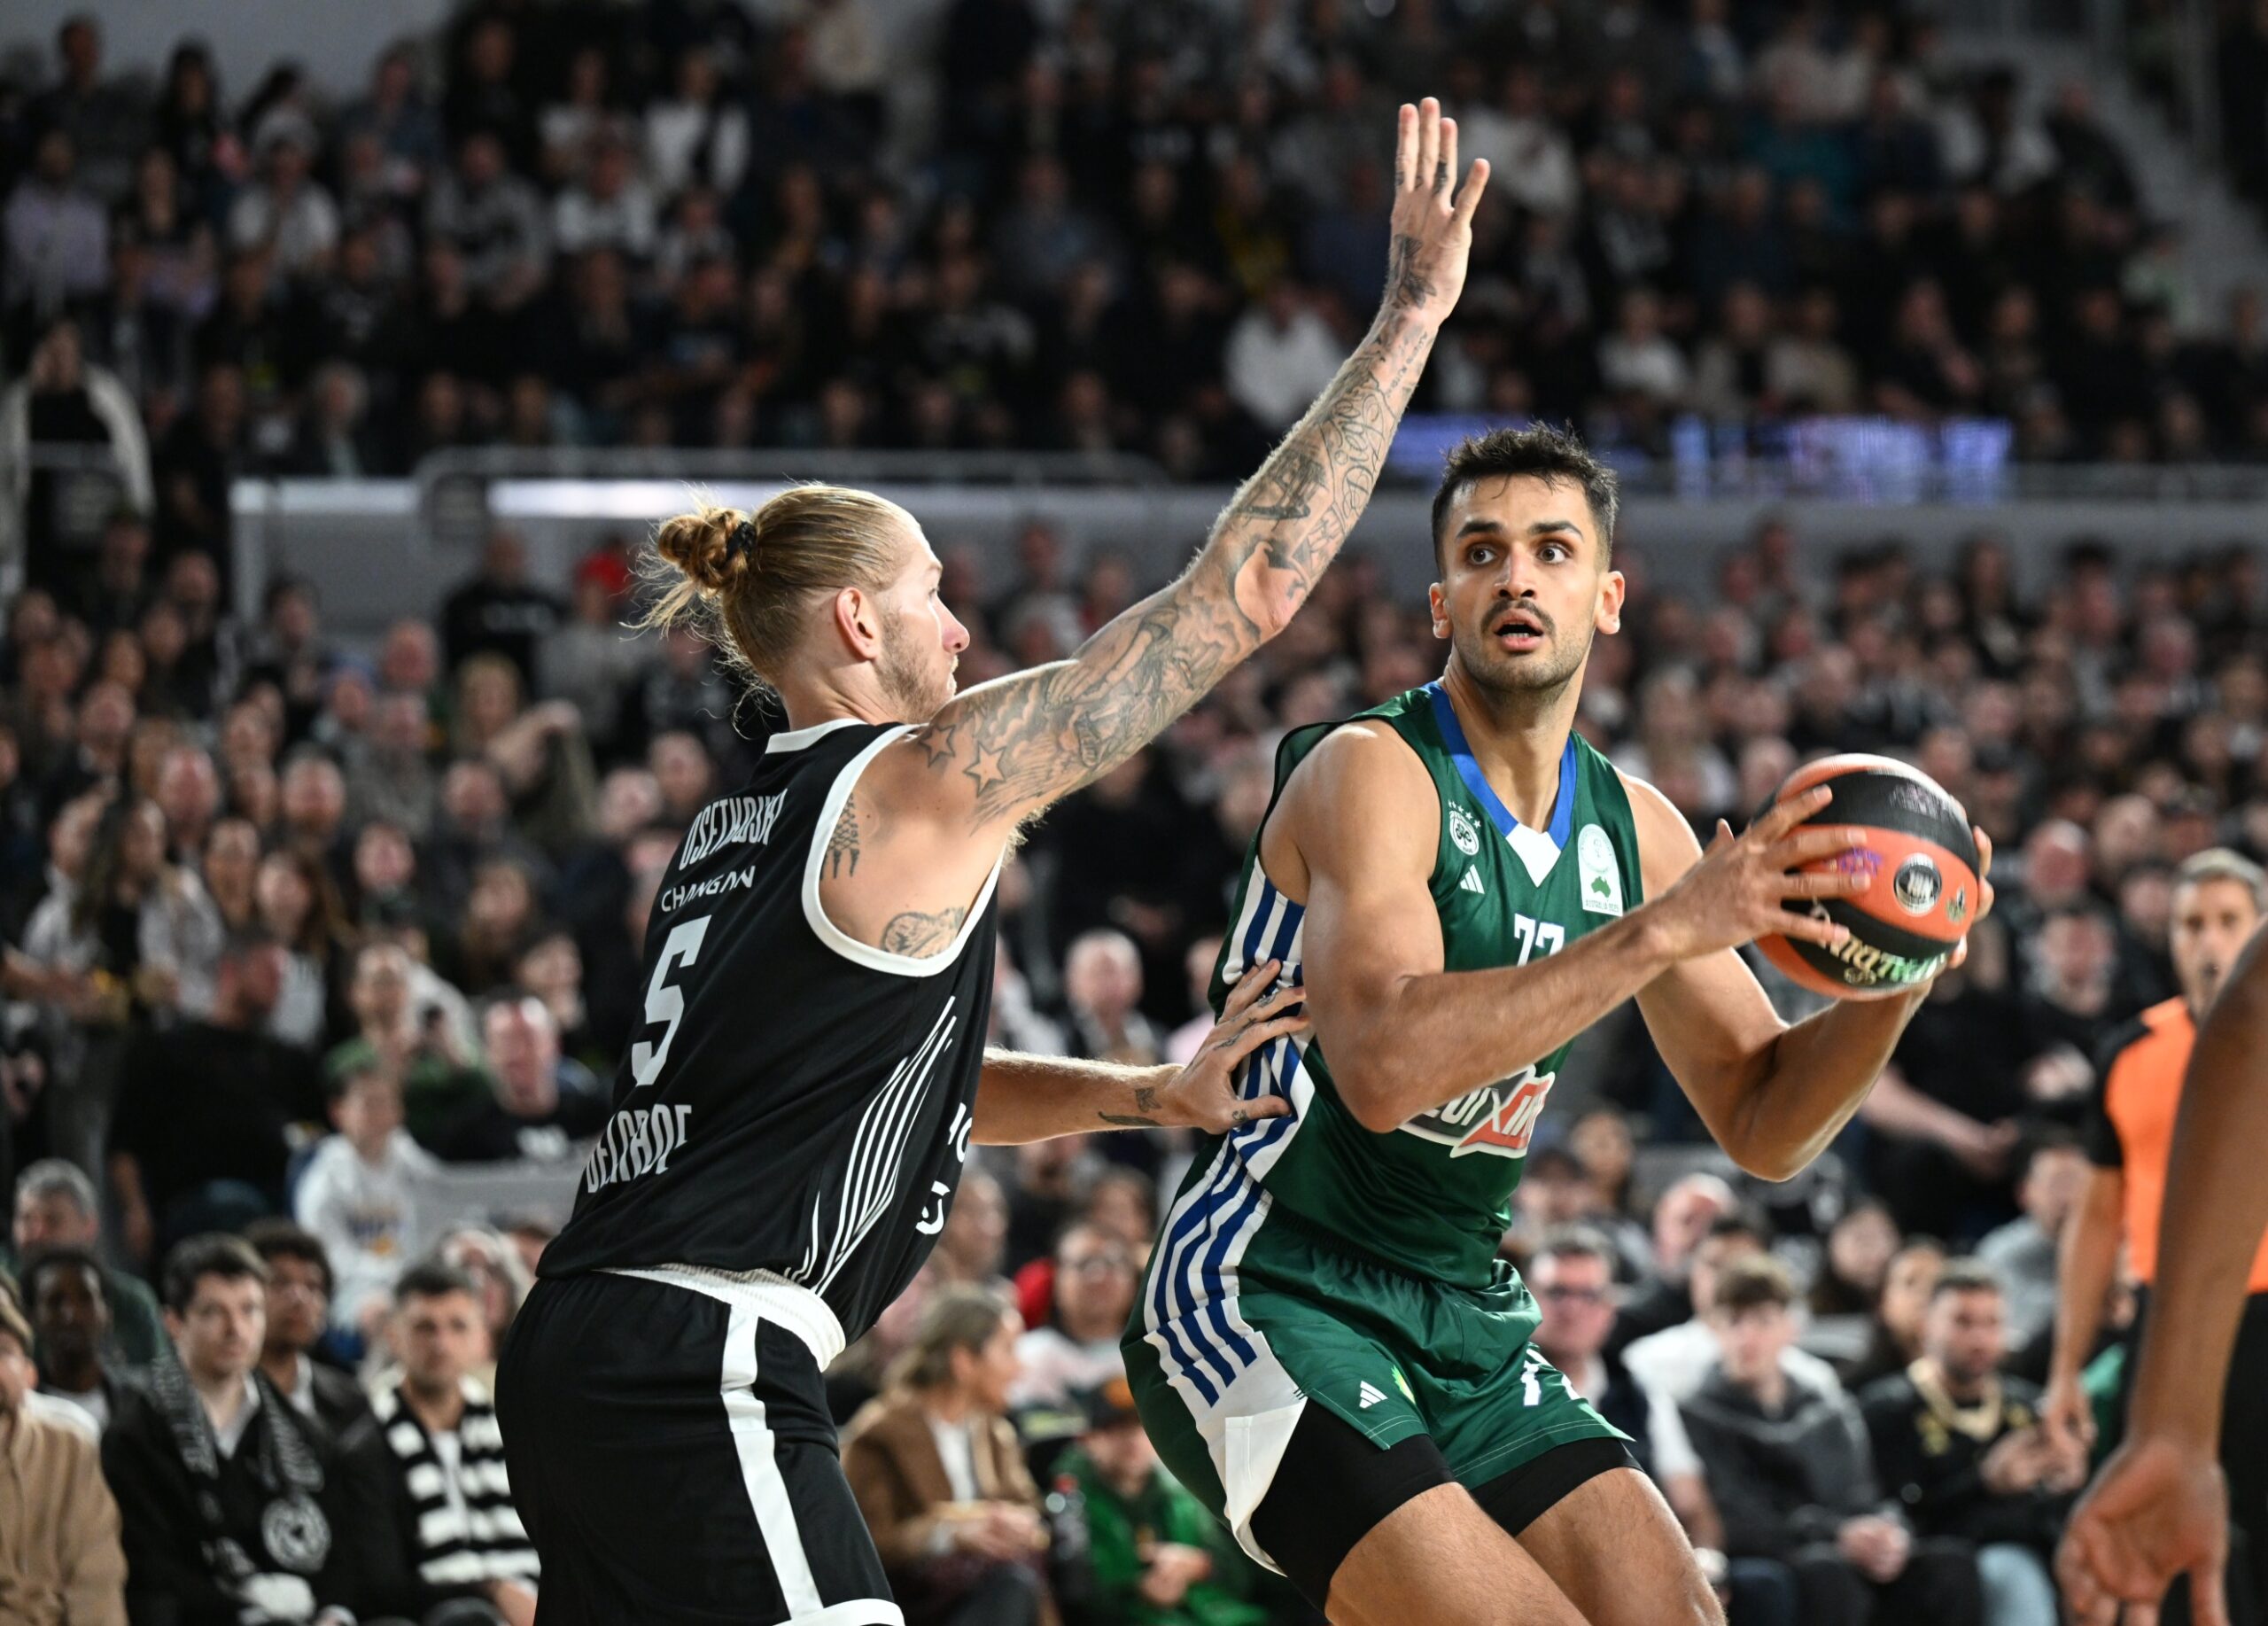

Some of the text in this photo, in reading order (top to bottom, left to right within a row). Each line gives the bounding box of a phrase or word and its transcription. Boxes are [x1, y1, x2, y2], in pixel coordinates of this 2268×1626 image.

[661, 865, 756, 912] CHANGAN
[1514, 913, 1565, 967] 77
[631, 915, 711, 1086] 5
